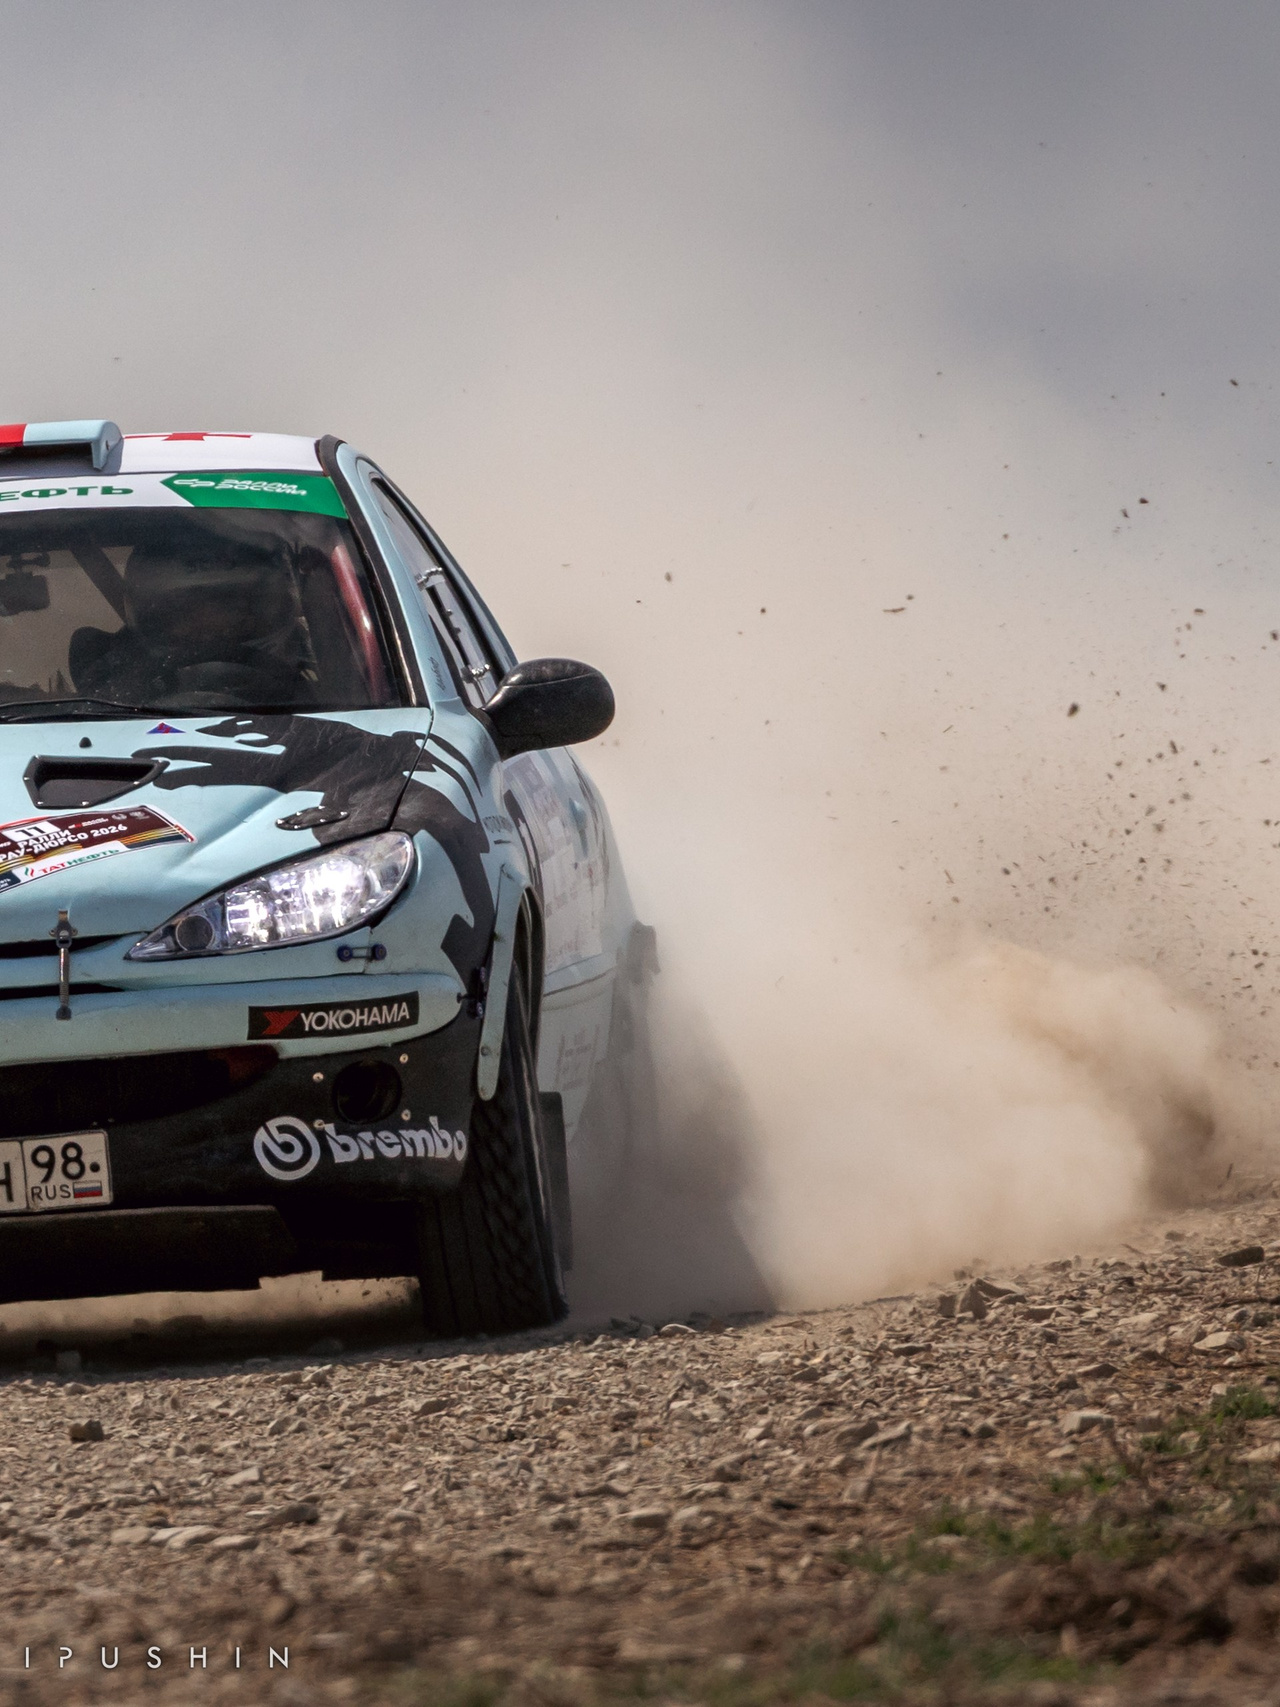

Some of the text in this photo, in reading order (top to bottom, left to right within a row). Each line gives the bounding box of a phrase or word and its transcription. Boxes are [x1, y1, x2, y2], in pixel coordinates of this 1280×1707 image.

[15, 826, 46, 837] 11
[17, 829, 71, 849] РАЛЛИ
[90, 823, 128, 837] 2026
[39, 850, 120, 874] ТАТНЕФТЬ
[301, 1002, 410, 1031] YOKOHAMA
[324, 1116, 468, 1163] brembo
[31, 1142, 86, 1183] 98
[31, 1180, 71, 1201] RUS
